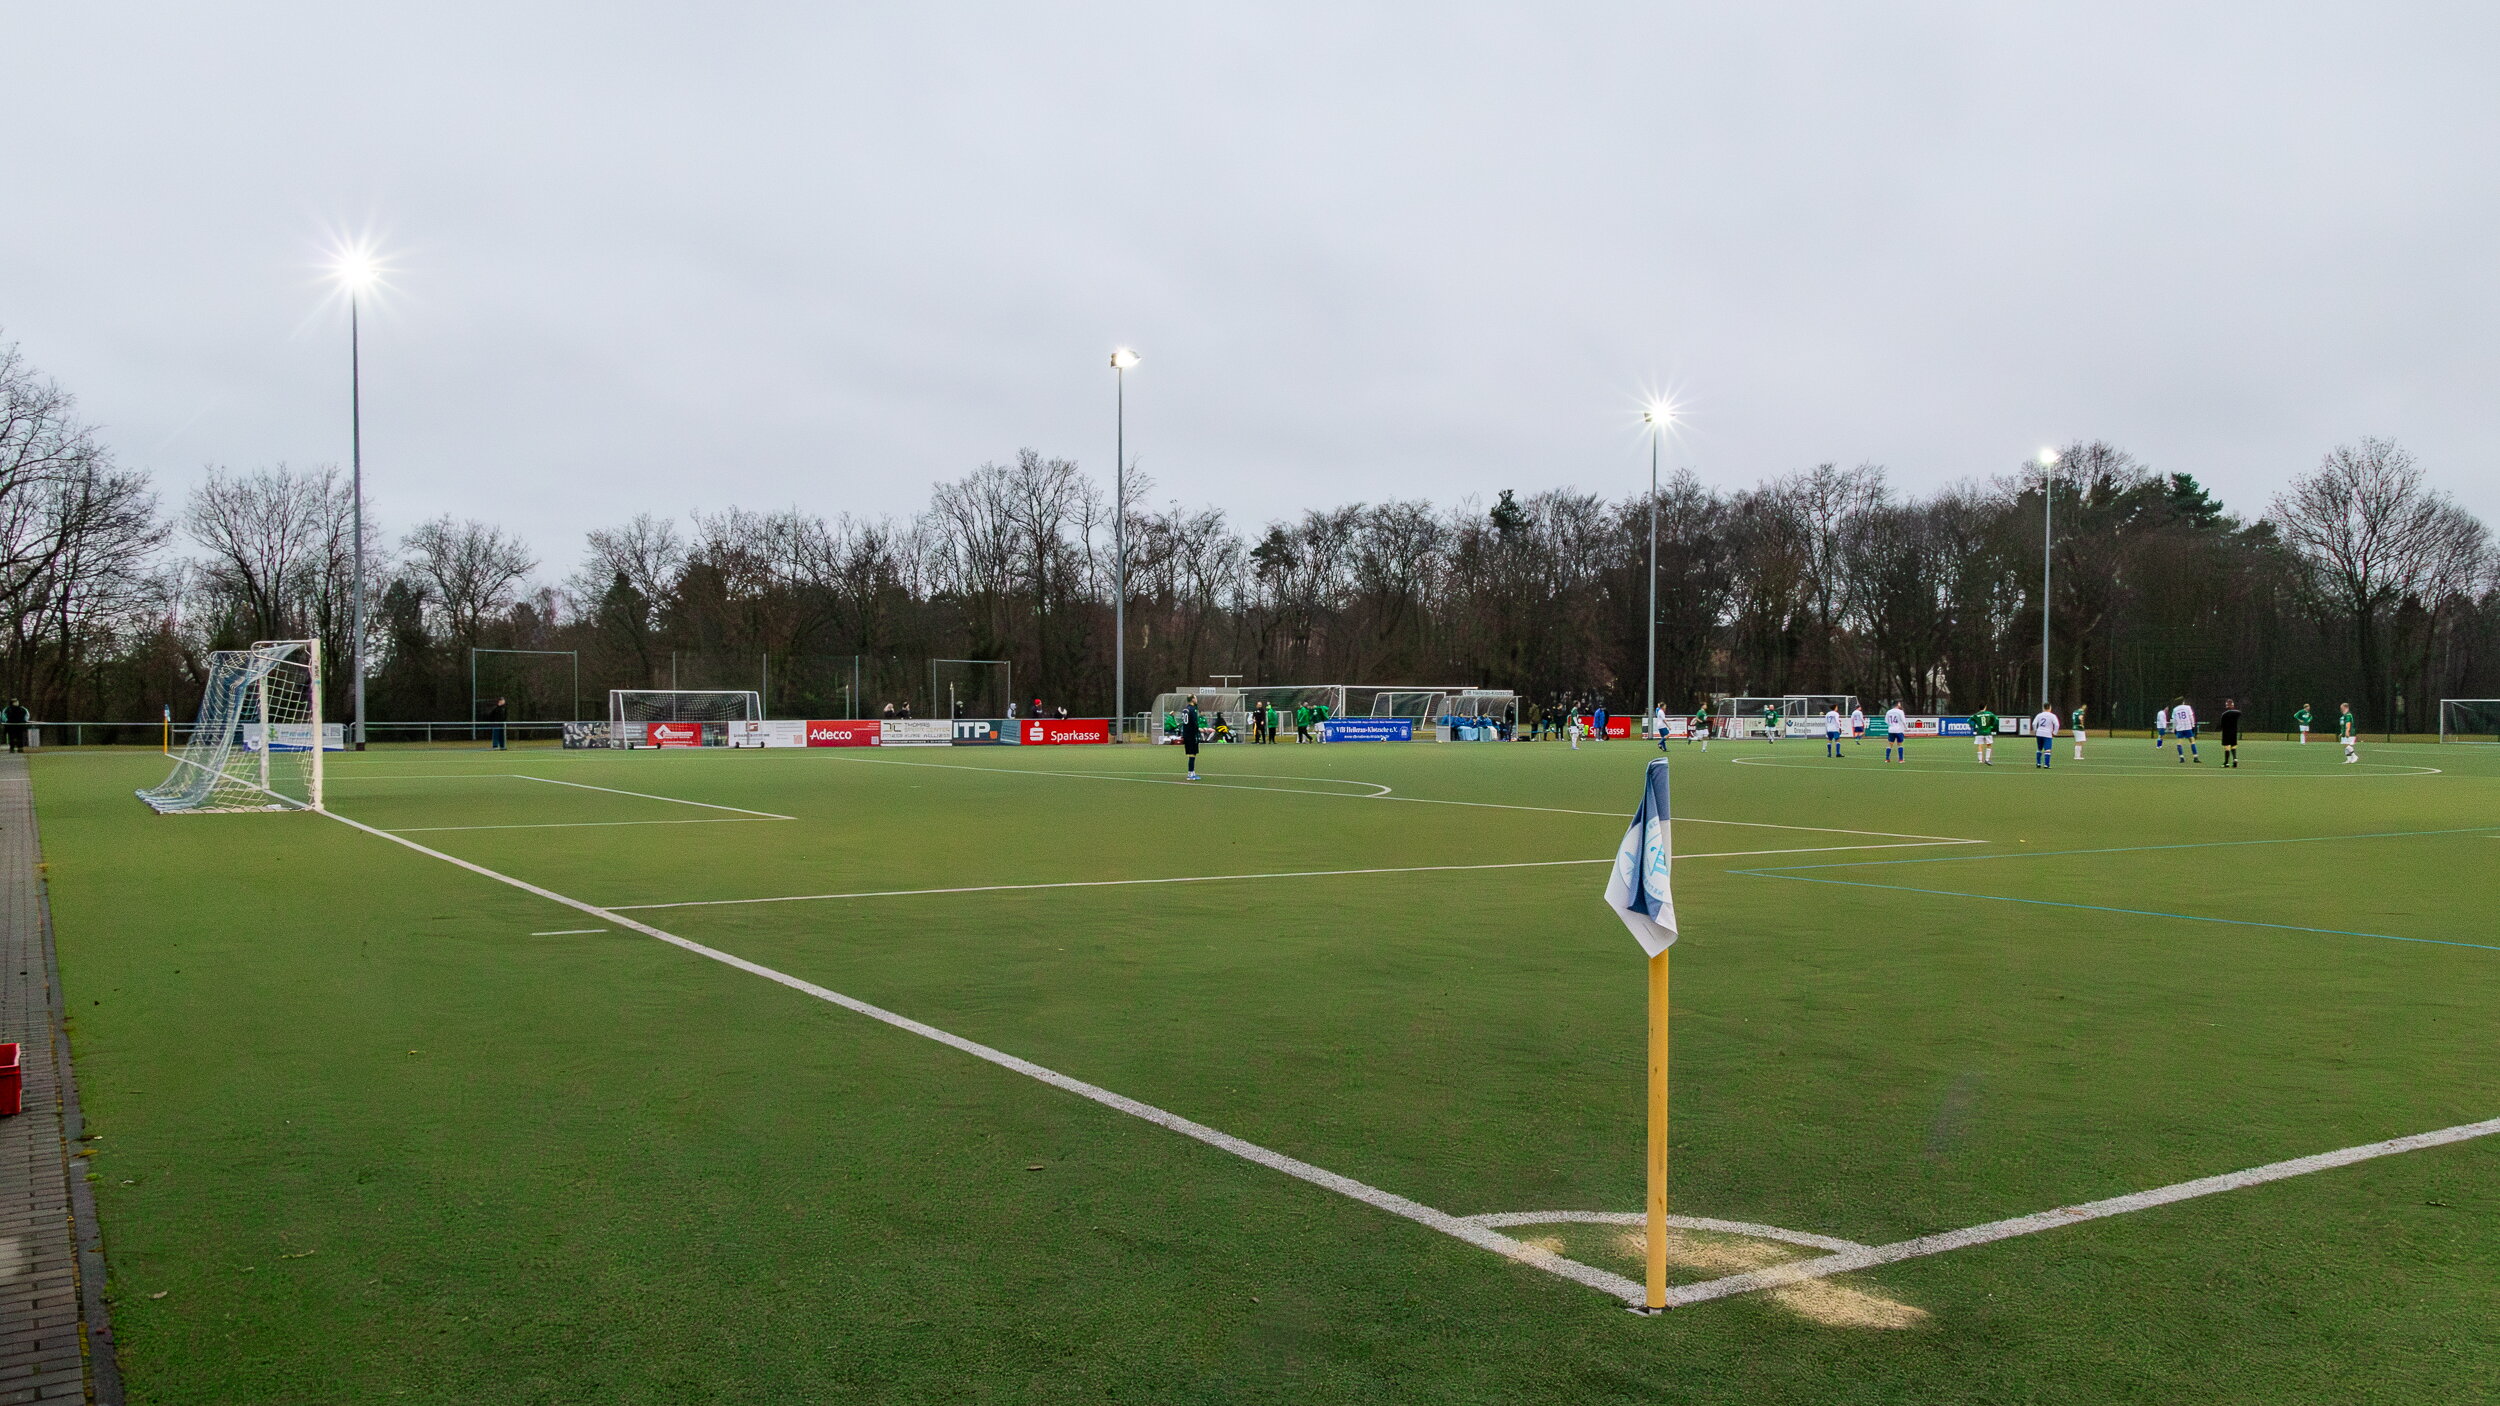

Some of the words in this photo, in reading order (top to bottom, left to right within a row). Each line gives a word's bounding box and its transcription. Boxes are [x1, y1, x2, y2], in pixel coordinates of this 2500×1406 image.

[1889, 715, 1899, 724] 14
[2040, 718, 2047, 728] 2
[810, 729, 852, 740] Adecco
[1050, 730, 1100, 742] Sparkasse
